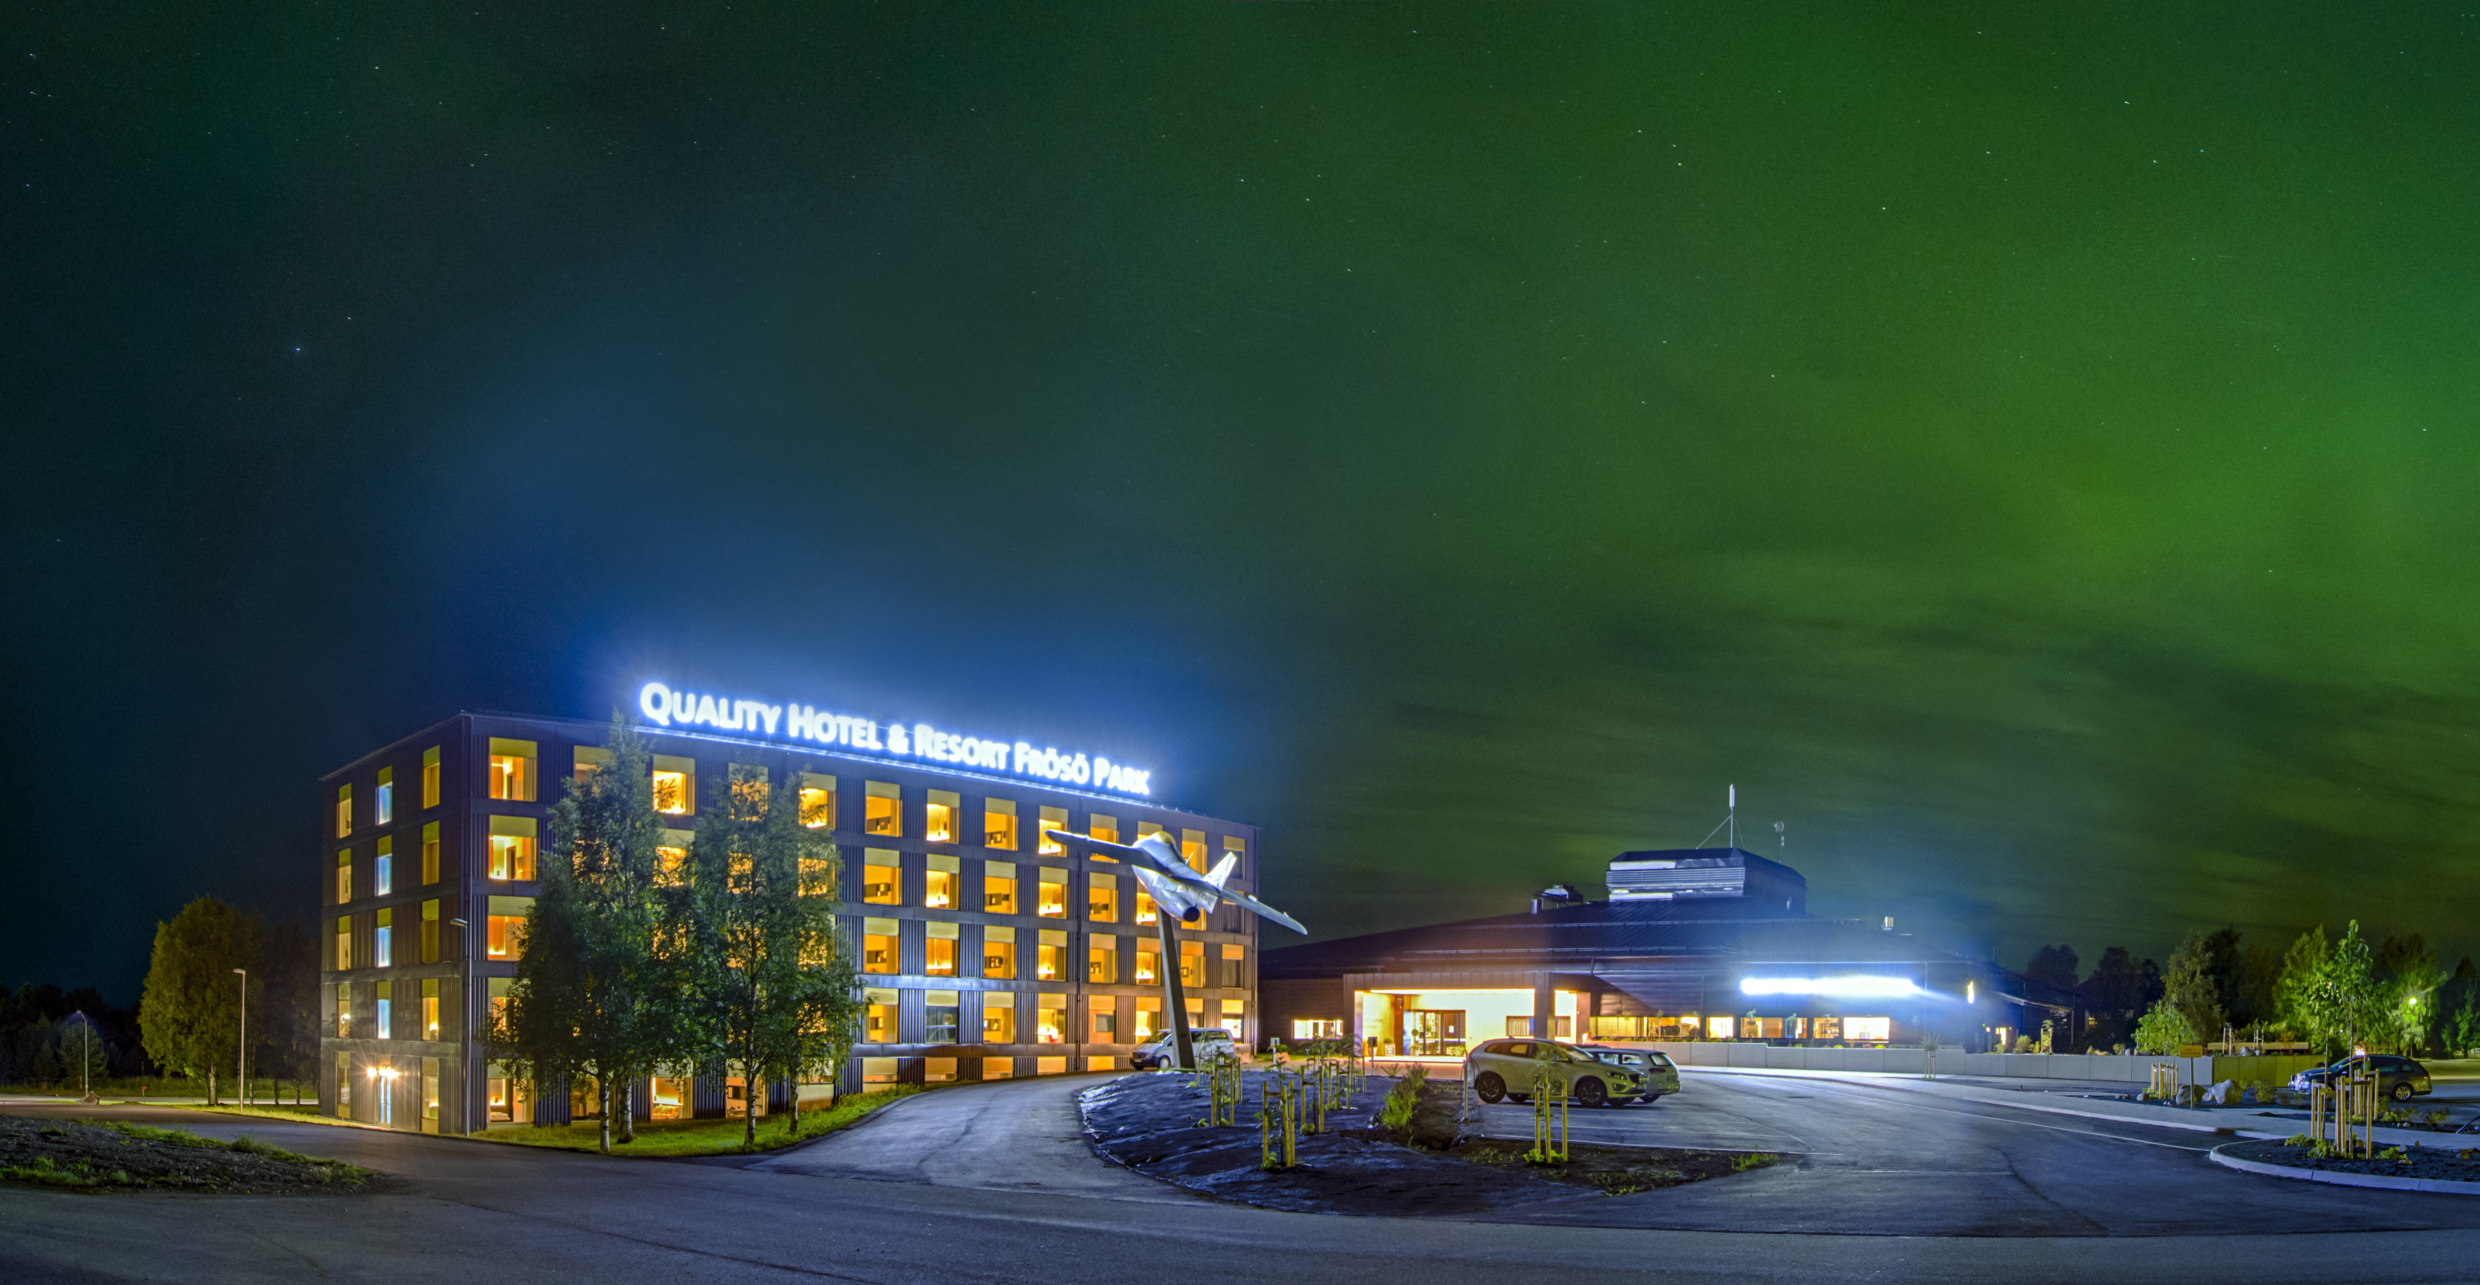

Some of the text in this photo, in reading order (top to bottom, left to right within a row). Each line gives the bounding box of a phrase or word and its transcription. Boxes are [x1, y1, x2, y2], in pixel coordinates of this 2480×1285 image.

[640, 682, 1150, 795] QUALITY HOTEL & RESORT FRÖSÖ PARK
